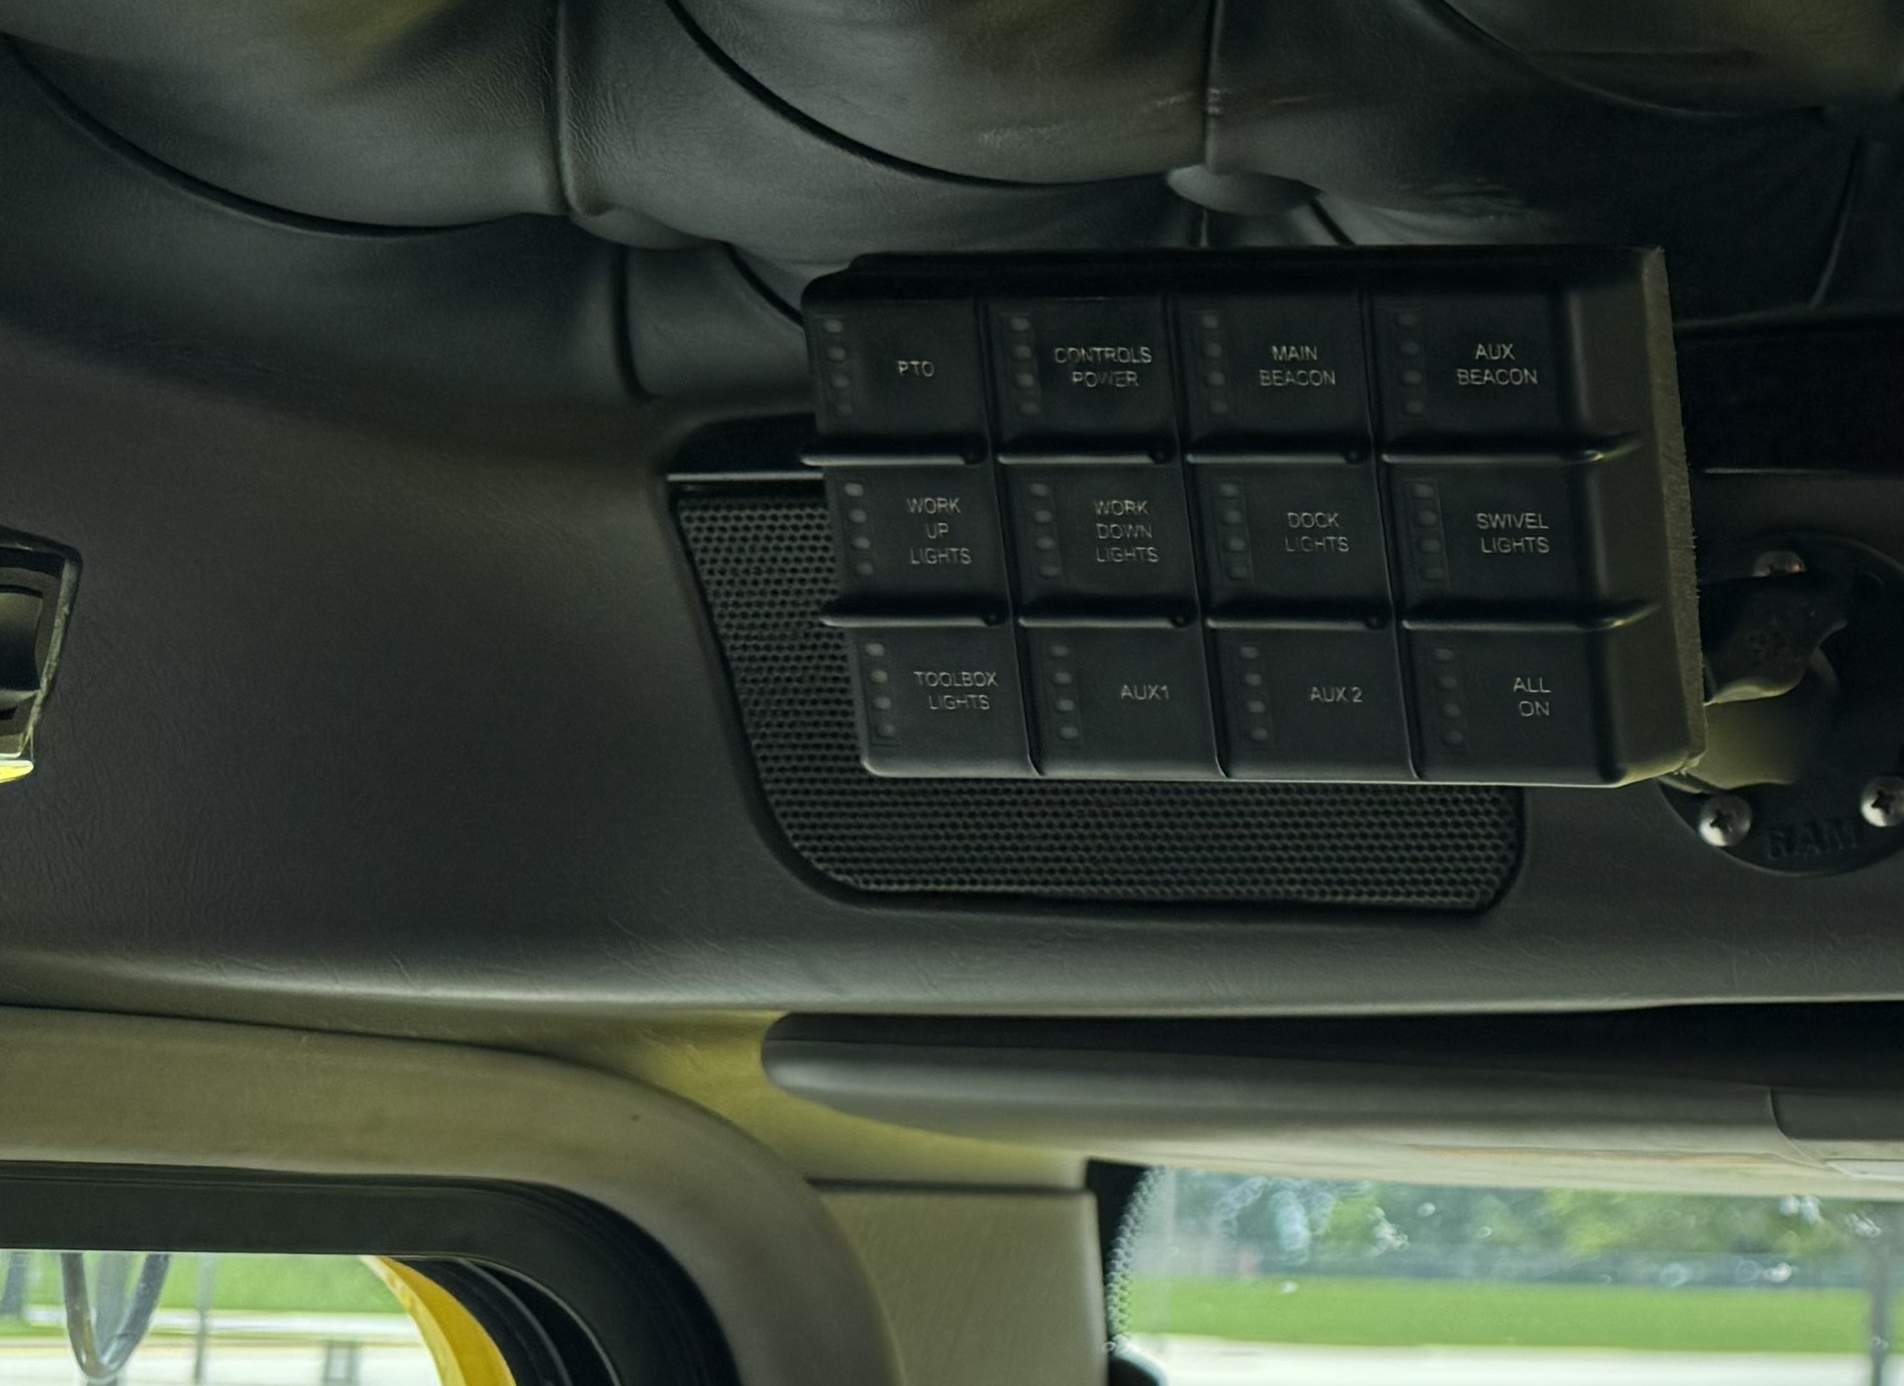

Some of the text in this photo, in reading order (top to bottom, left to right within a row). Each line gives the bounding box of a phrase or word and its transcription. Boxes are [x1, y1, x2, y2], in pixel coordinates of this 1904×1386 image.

[1055, 346, 1152, 364] CONTROLS
[1271, 345, 1318, 361] MAIN
[1475, 343, 1515, 361] AUX
[898, 360, 934, 378] PTO
[1456, 368, 1538, 386] BEACON
[1072, 370, 1140, 387] POWER
[1259, 369, 1336, 387] BEACON
[907, 497, 961, 514] WORK
[1094, 500, 1149, 516] WORK
[1287, 512, 1340, 528] DOCK
[1476, 512, 1549, 530] SWIVEL
[926, 522, 949, 539] UP
[1096, 523, 1152, 539] DOWN
[1285, 535, 1349, 552] LIGHTS
[1481, 536, 1550, 554] LIGHTS
[911, 548, 971, 565] LIGHTS
[1096, 546, 1159, 563] LIGHTS
[913, 671, 998, 688] TOOLBOX
[1513, 676, 1551, 694] ALL
[928, 694, 990, 710] LIGHTS
[1310, 685, 1363, 703] AUX 2
[1518, 700, 1550, 717] ON
